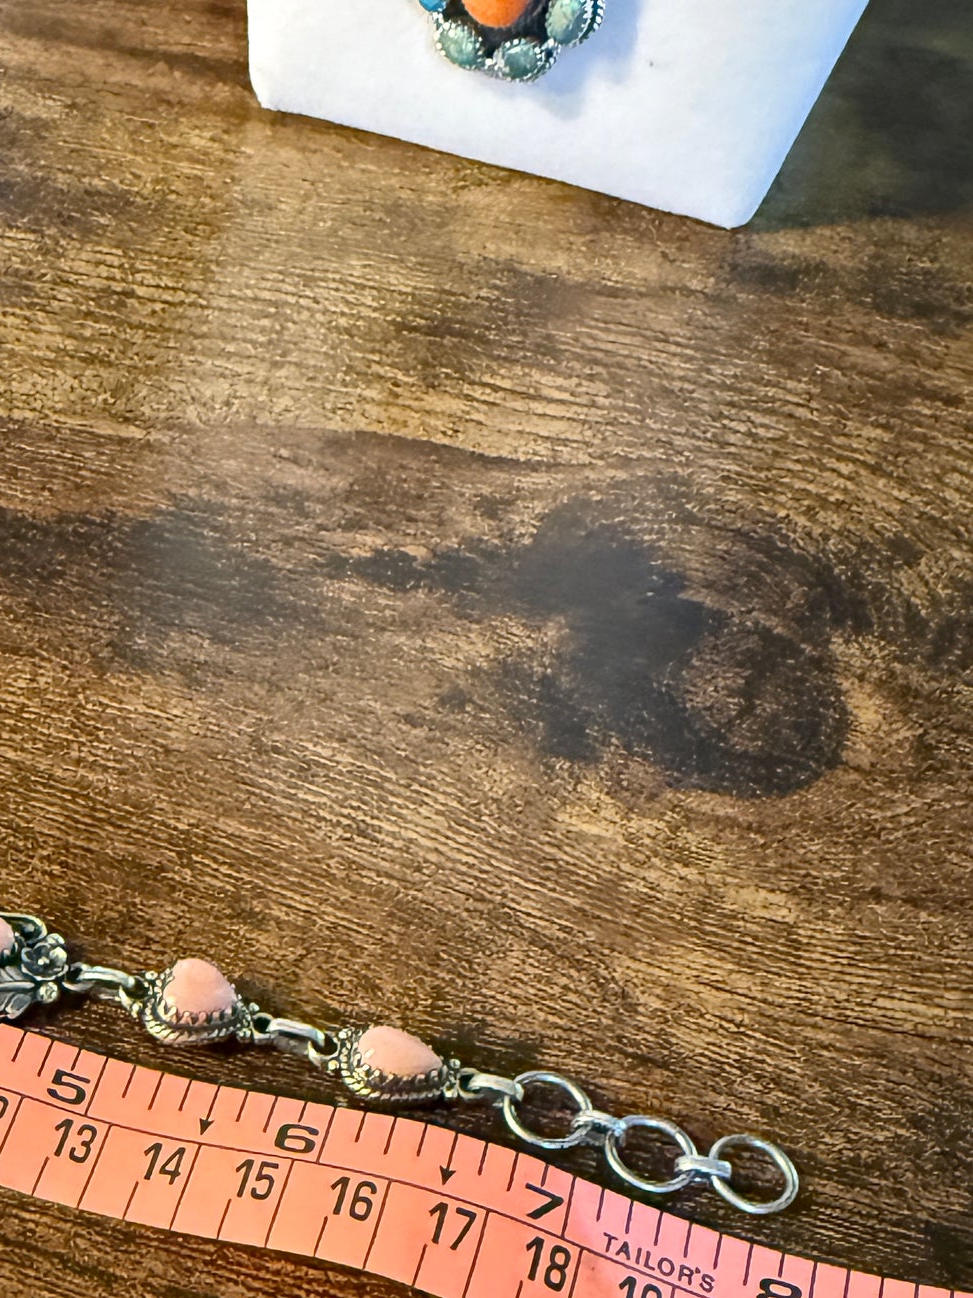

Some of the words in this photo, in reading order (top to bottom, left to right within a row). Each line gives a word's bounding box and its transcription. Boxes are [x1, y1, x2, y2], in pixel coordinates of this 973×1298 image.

[46, 1069, 91, 1106] 5
[53, 1118, 98, 1164] 13
[274, 1122, 320, 1154] 6
[143, 1141, 187, 1185] 14
[235, 1158, 279, 1201] 15
[330, 1176, 378, 1222] 16
[525, 1182, 565, 1220] 7
[429, 1202, 478, 1251] 17
[526, 1235, 571, 1292] 18
[603, 1231, 716, 1293] TAILOR'S
